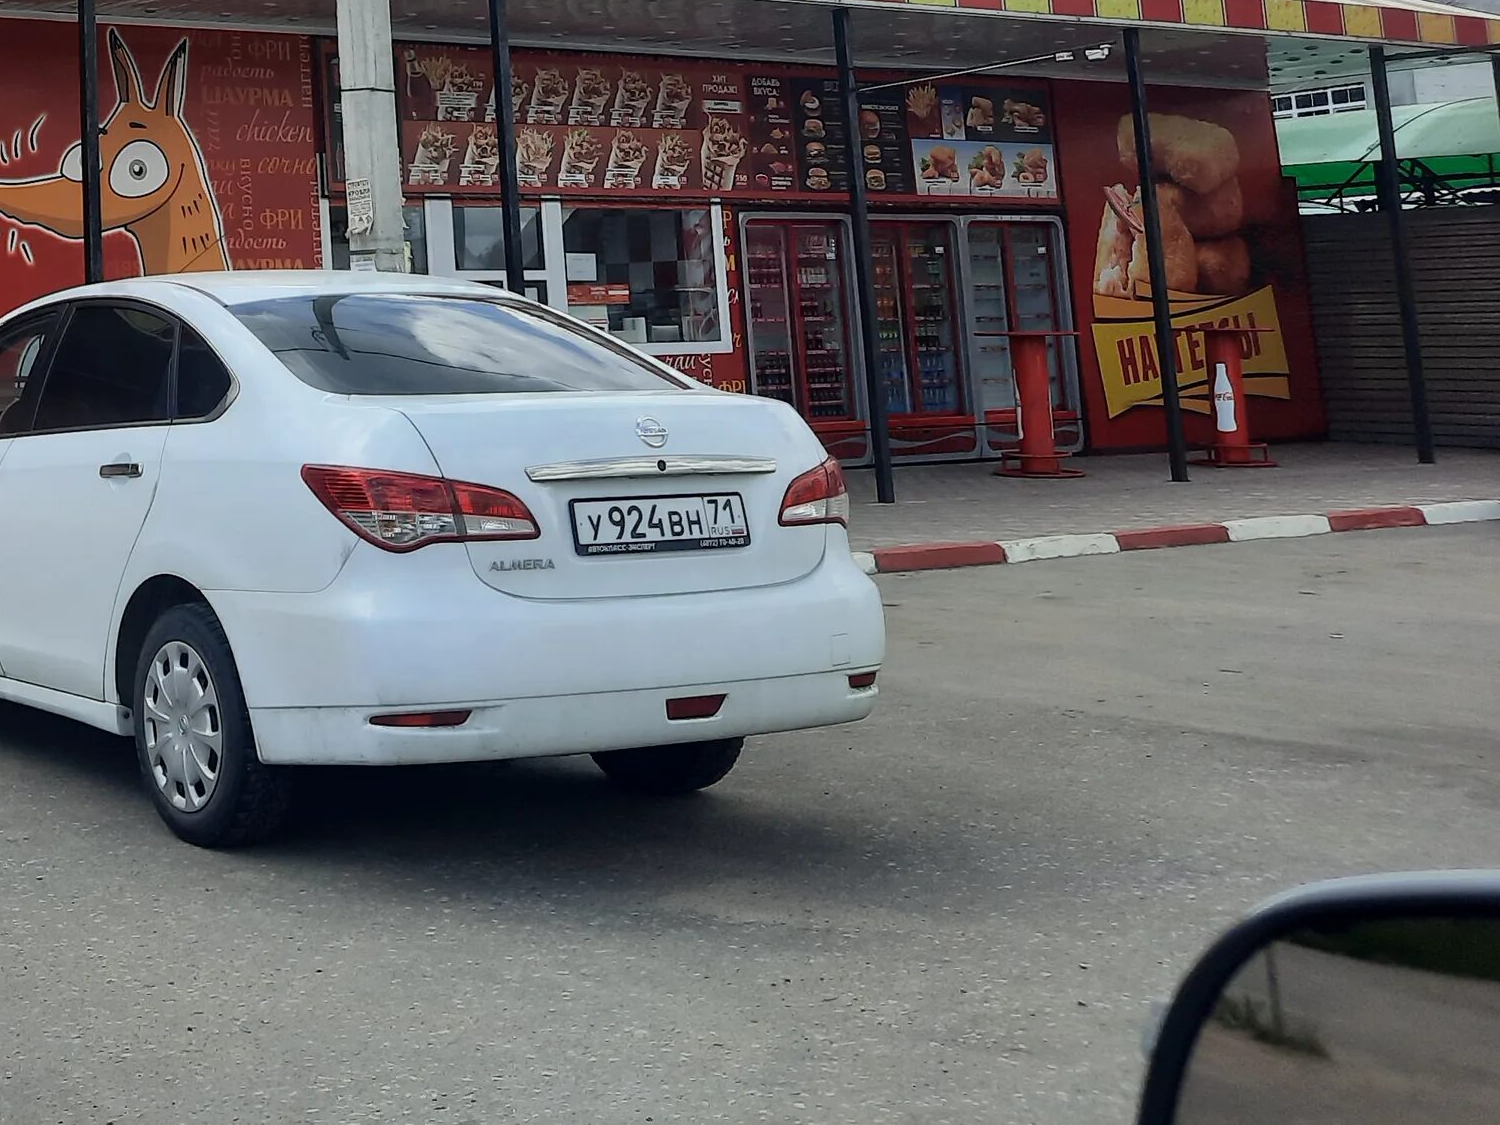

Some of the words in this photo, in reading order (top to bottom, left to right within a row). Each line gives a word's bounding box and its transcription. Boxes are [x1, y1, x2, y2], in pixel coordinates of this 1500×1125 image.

[236, 108, 314, 143] chicken
[257, 156, 316, 175] сочно
[260, 208, 304, 230] ФРИ
[711, 526, 731, 536] RUS
[489, 559, 556, 572] ALMERA
